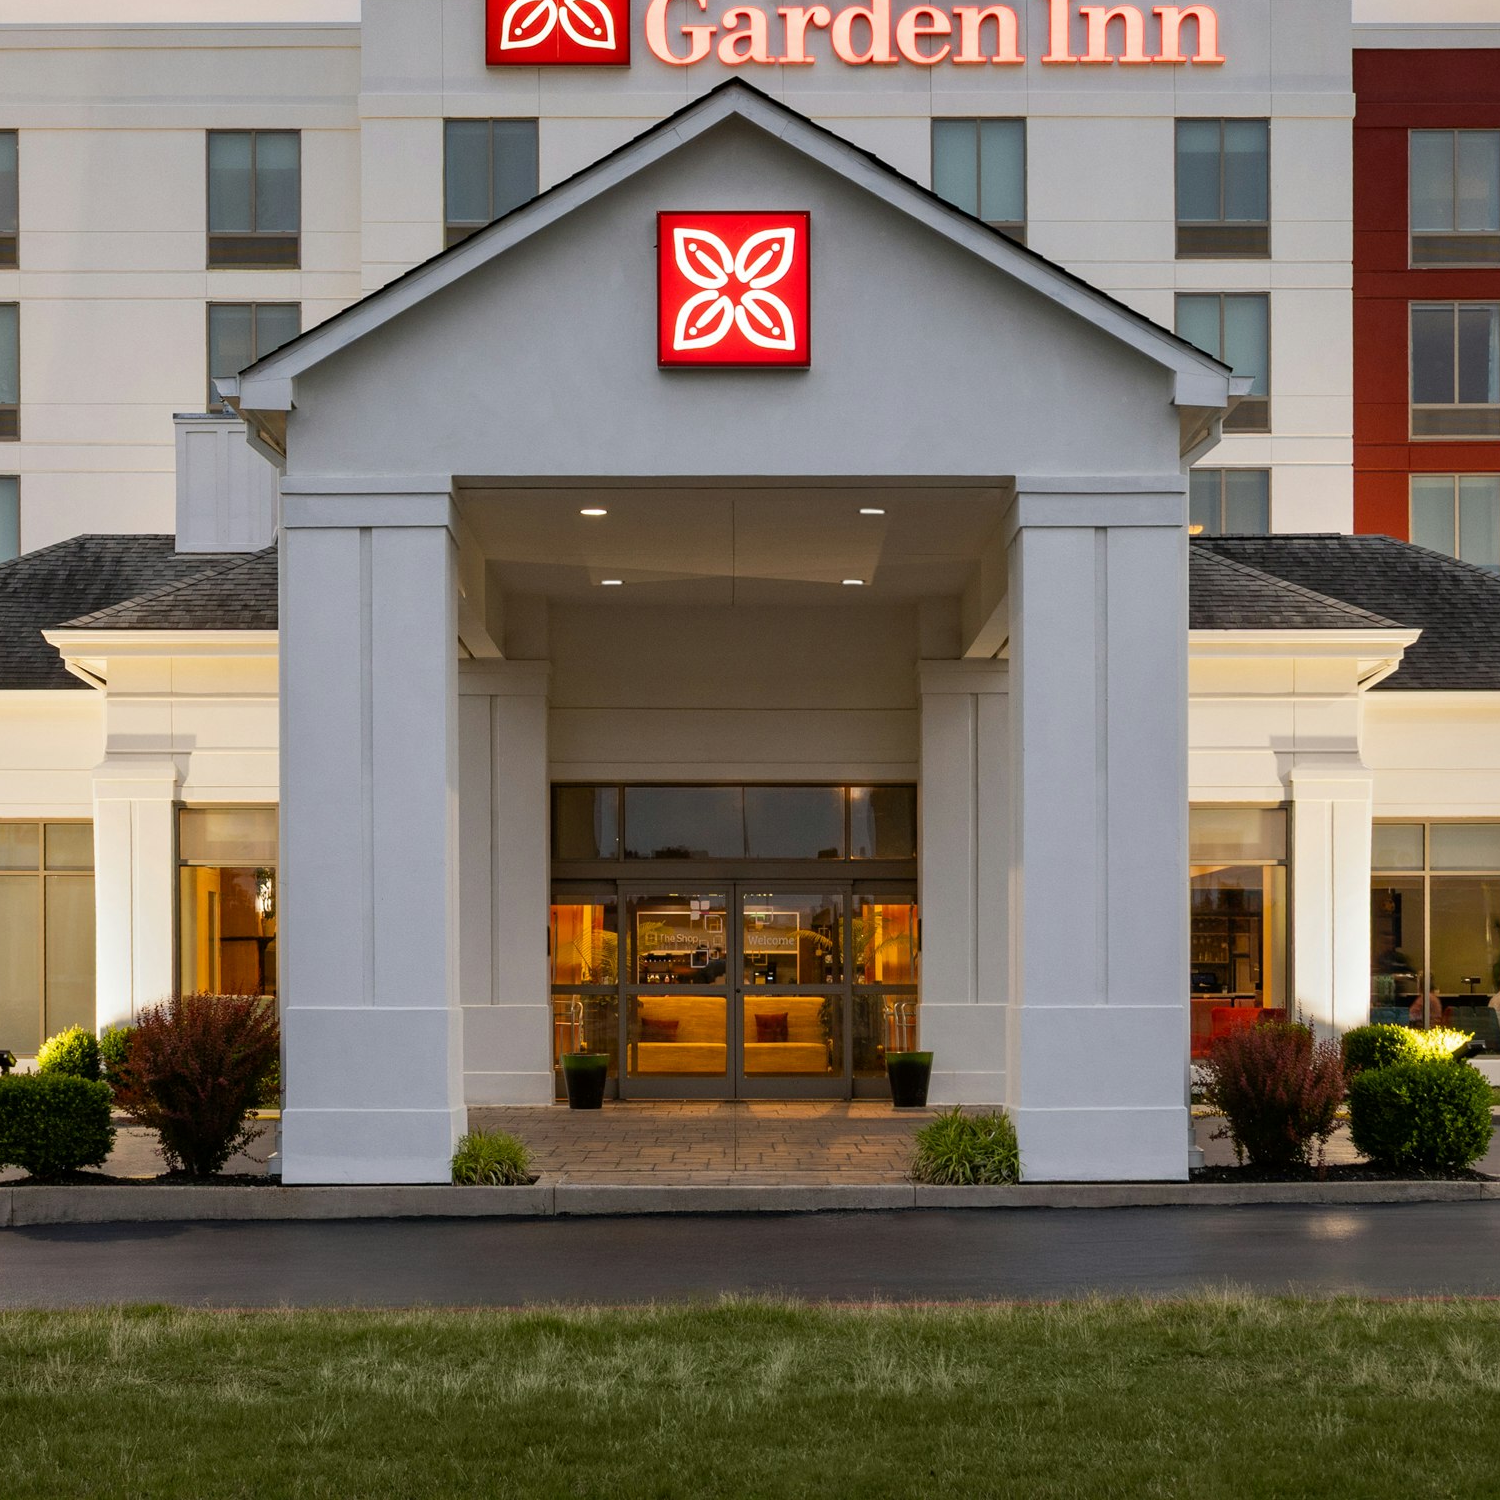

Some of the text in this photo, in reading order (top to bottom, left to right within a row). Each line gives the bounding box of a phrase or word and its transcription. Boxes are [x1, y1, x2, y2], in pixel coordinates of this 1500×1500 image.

[659, 933, 699, 945] The Shop
[747, 935, 795, 946] Welcome
